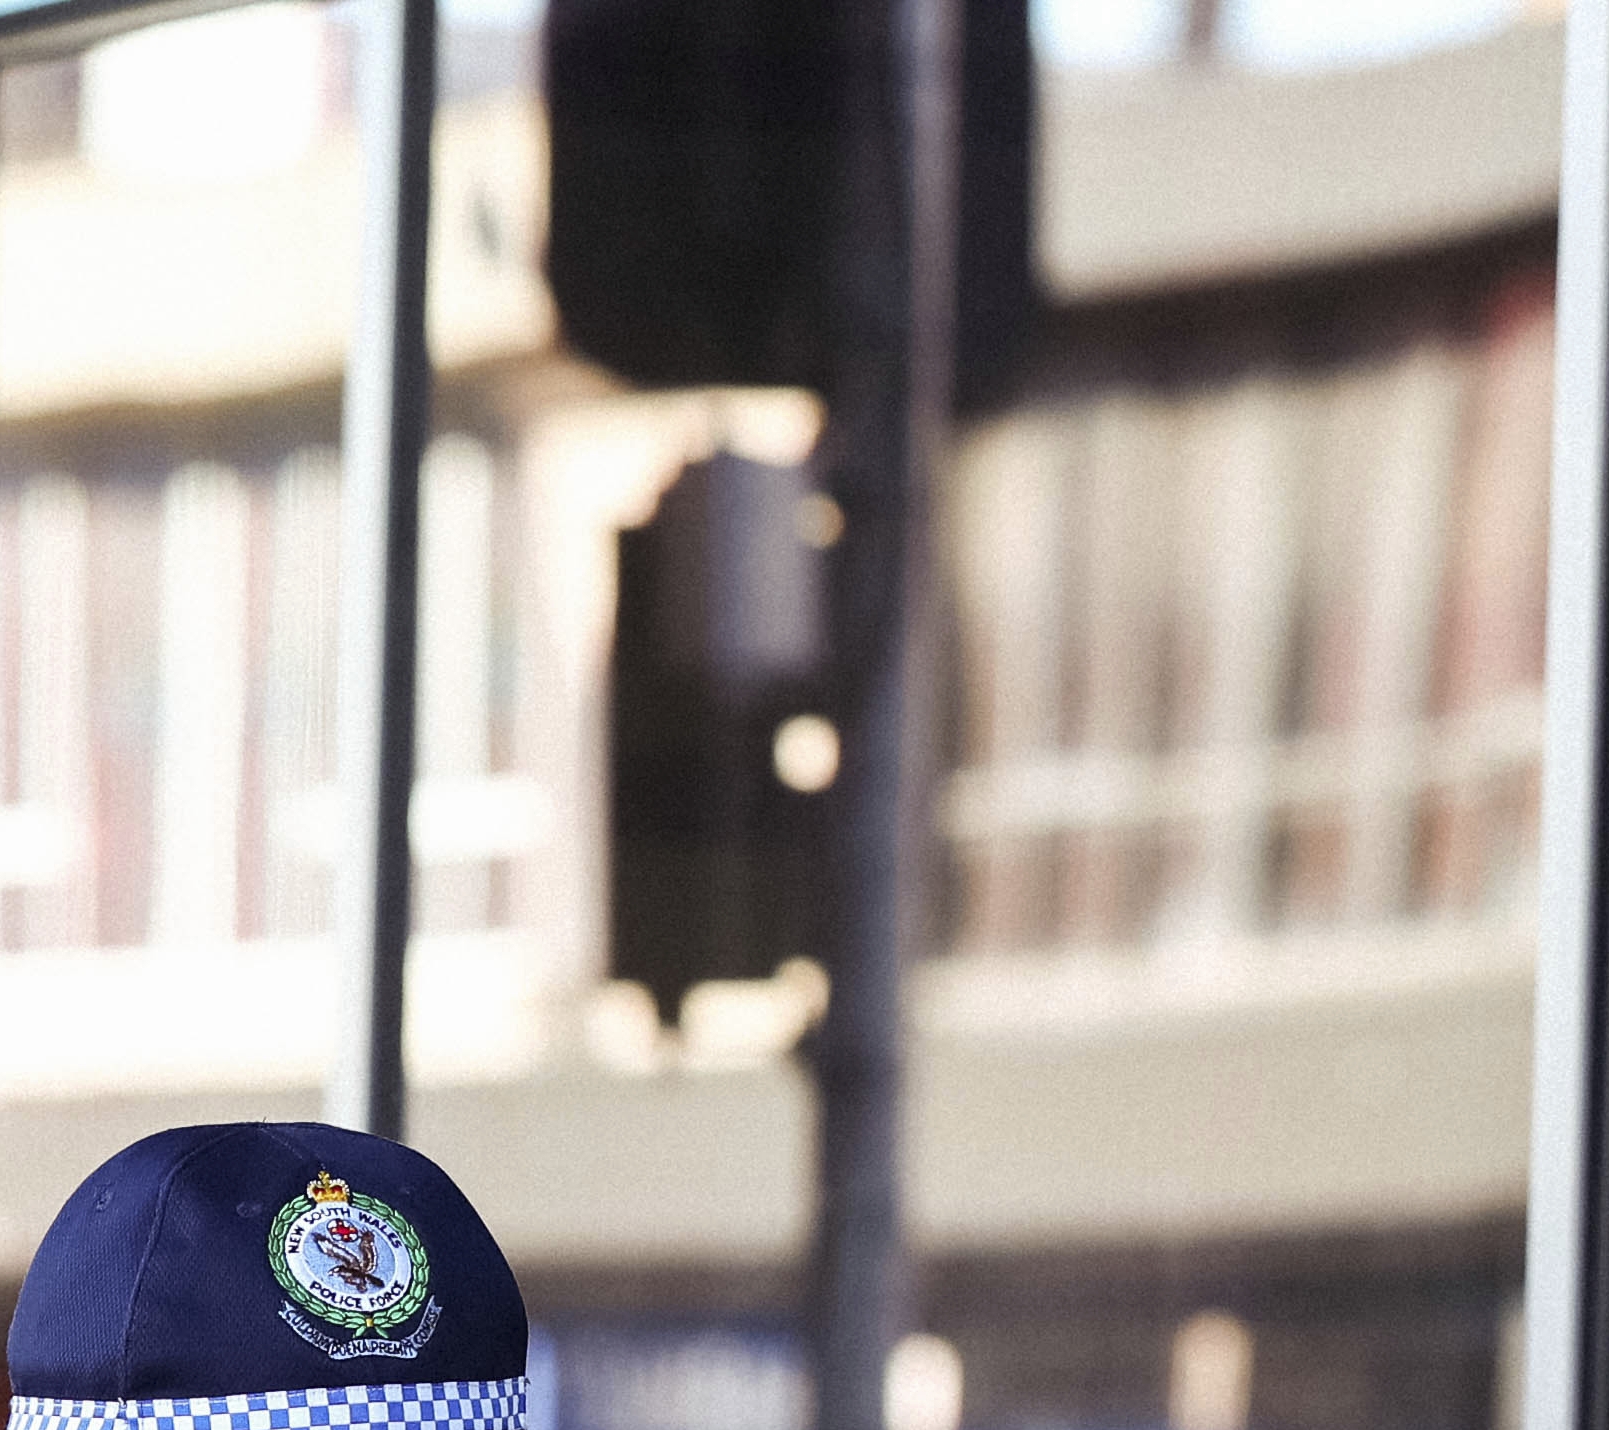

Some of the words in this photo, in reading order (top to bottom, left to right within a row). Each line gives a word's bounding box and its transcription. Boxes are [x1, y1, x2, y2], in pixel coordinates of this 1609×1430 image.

[288, 1225, 305, 1254] NEW
[304, 1207, 351, 1225] SOUTH
[358, 1212, 403, 1249] WALES
[309, 1280, 362, 1309] POLICE
[368, 1280, 405, 1308] FORCE
